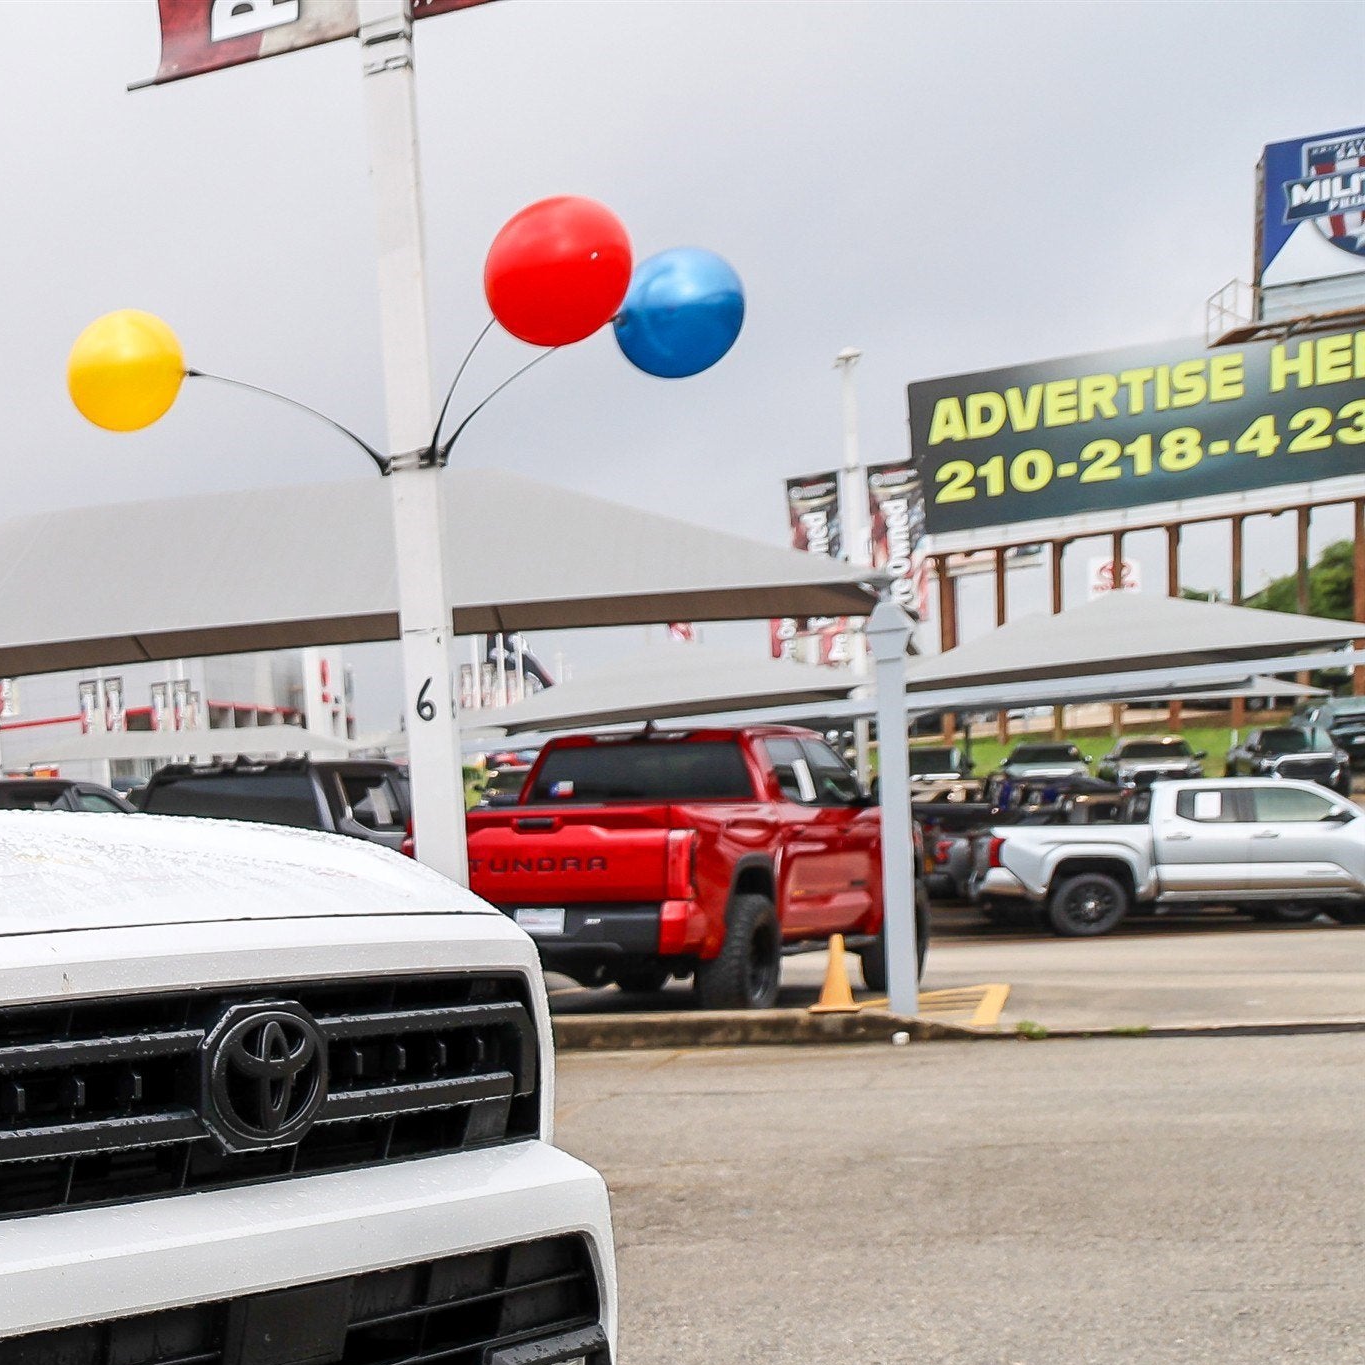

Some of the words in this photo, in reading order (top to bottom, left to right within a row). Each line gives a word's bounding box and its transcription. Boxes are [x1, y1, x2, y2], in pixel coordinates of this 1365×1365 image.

[928, 352, 1244, 445] ADVERTISE
[935, 398, 1365, 503] 210-218-423
[416, 676, 436, 721] 6
[469, 857, 608, 873] TUNDRA
